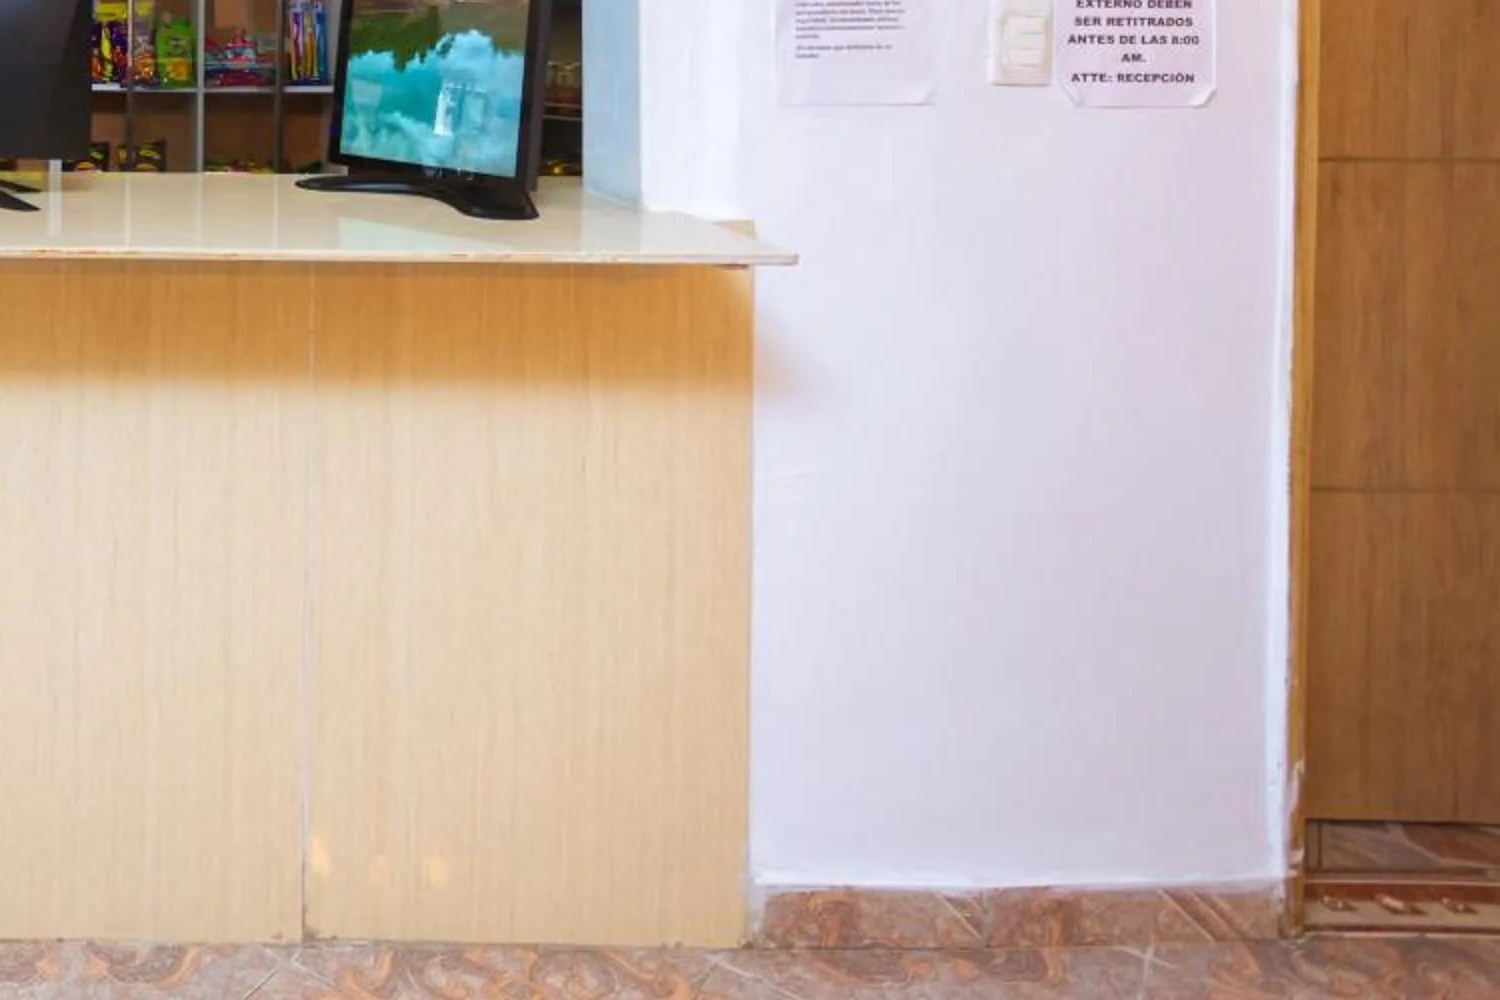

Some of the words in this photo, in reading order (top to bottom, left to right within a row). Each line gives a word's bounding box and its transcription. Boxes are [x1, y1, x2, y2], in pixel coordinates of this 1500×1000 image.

[1076, 0, 1142, 8] EXTERNO
[1148, 0, 1192, 8] DEBEN
[1075, 17, 1101, 26] SER
[1106, 17, 1193, 26] RETITRADOS
[1067, 35, 1115, 44] ANTES
[1119, 35, 1137, 45] DE
[1141, 35, 1167, 44] LAS
[1121, 53, 1147, 62] AM.
[1072, 74, 1112, 83] ATTE:
